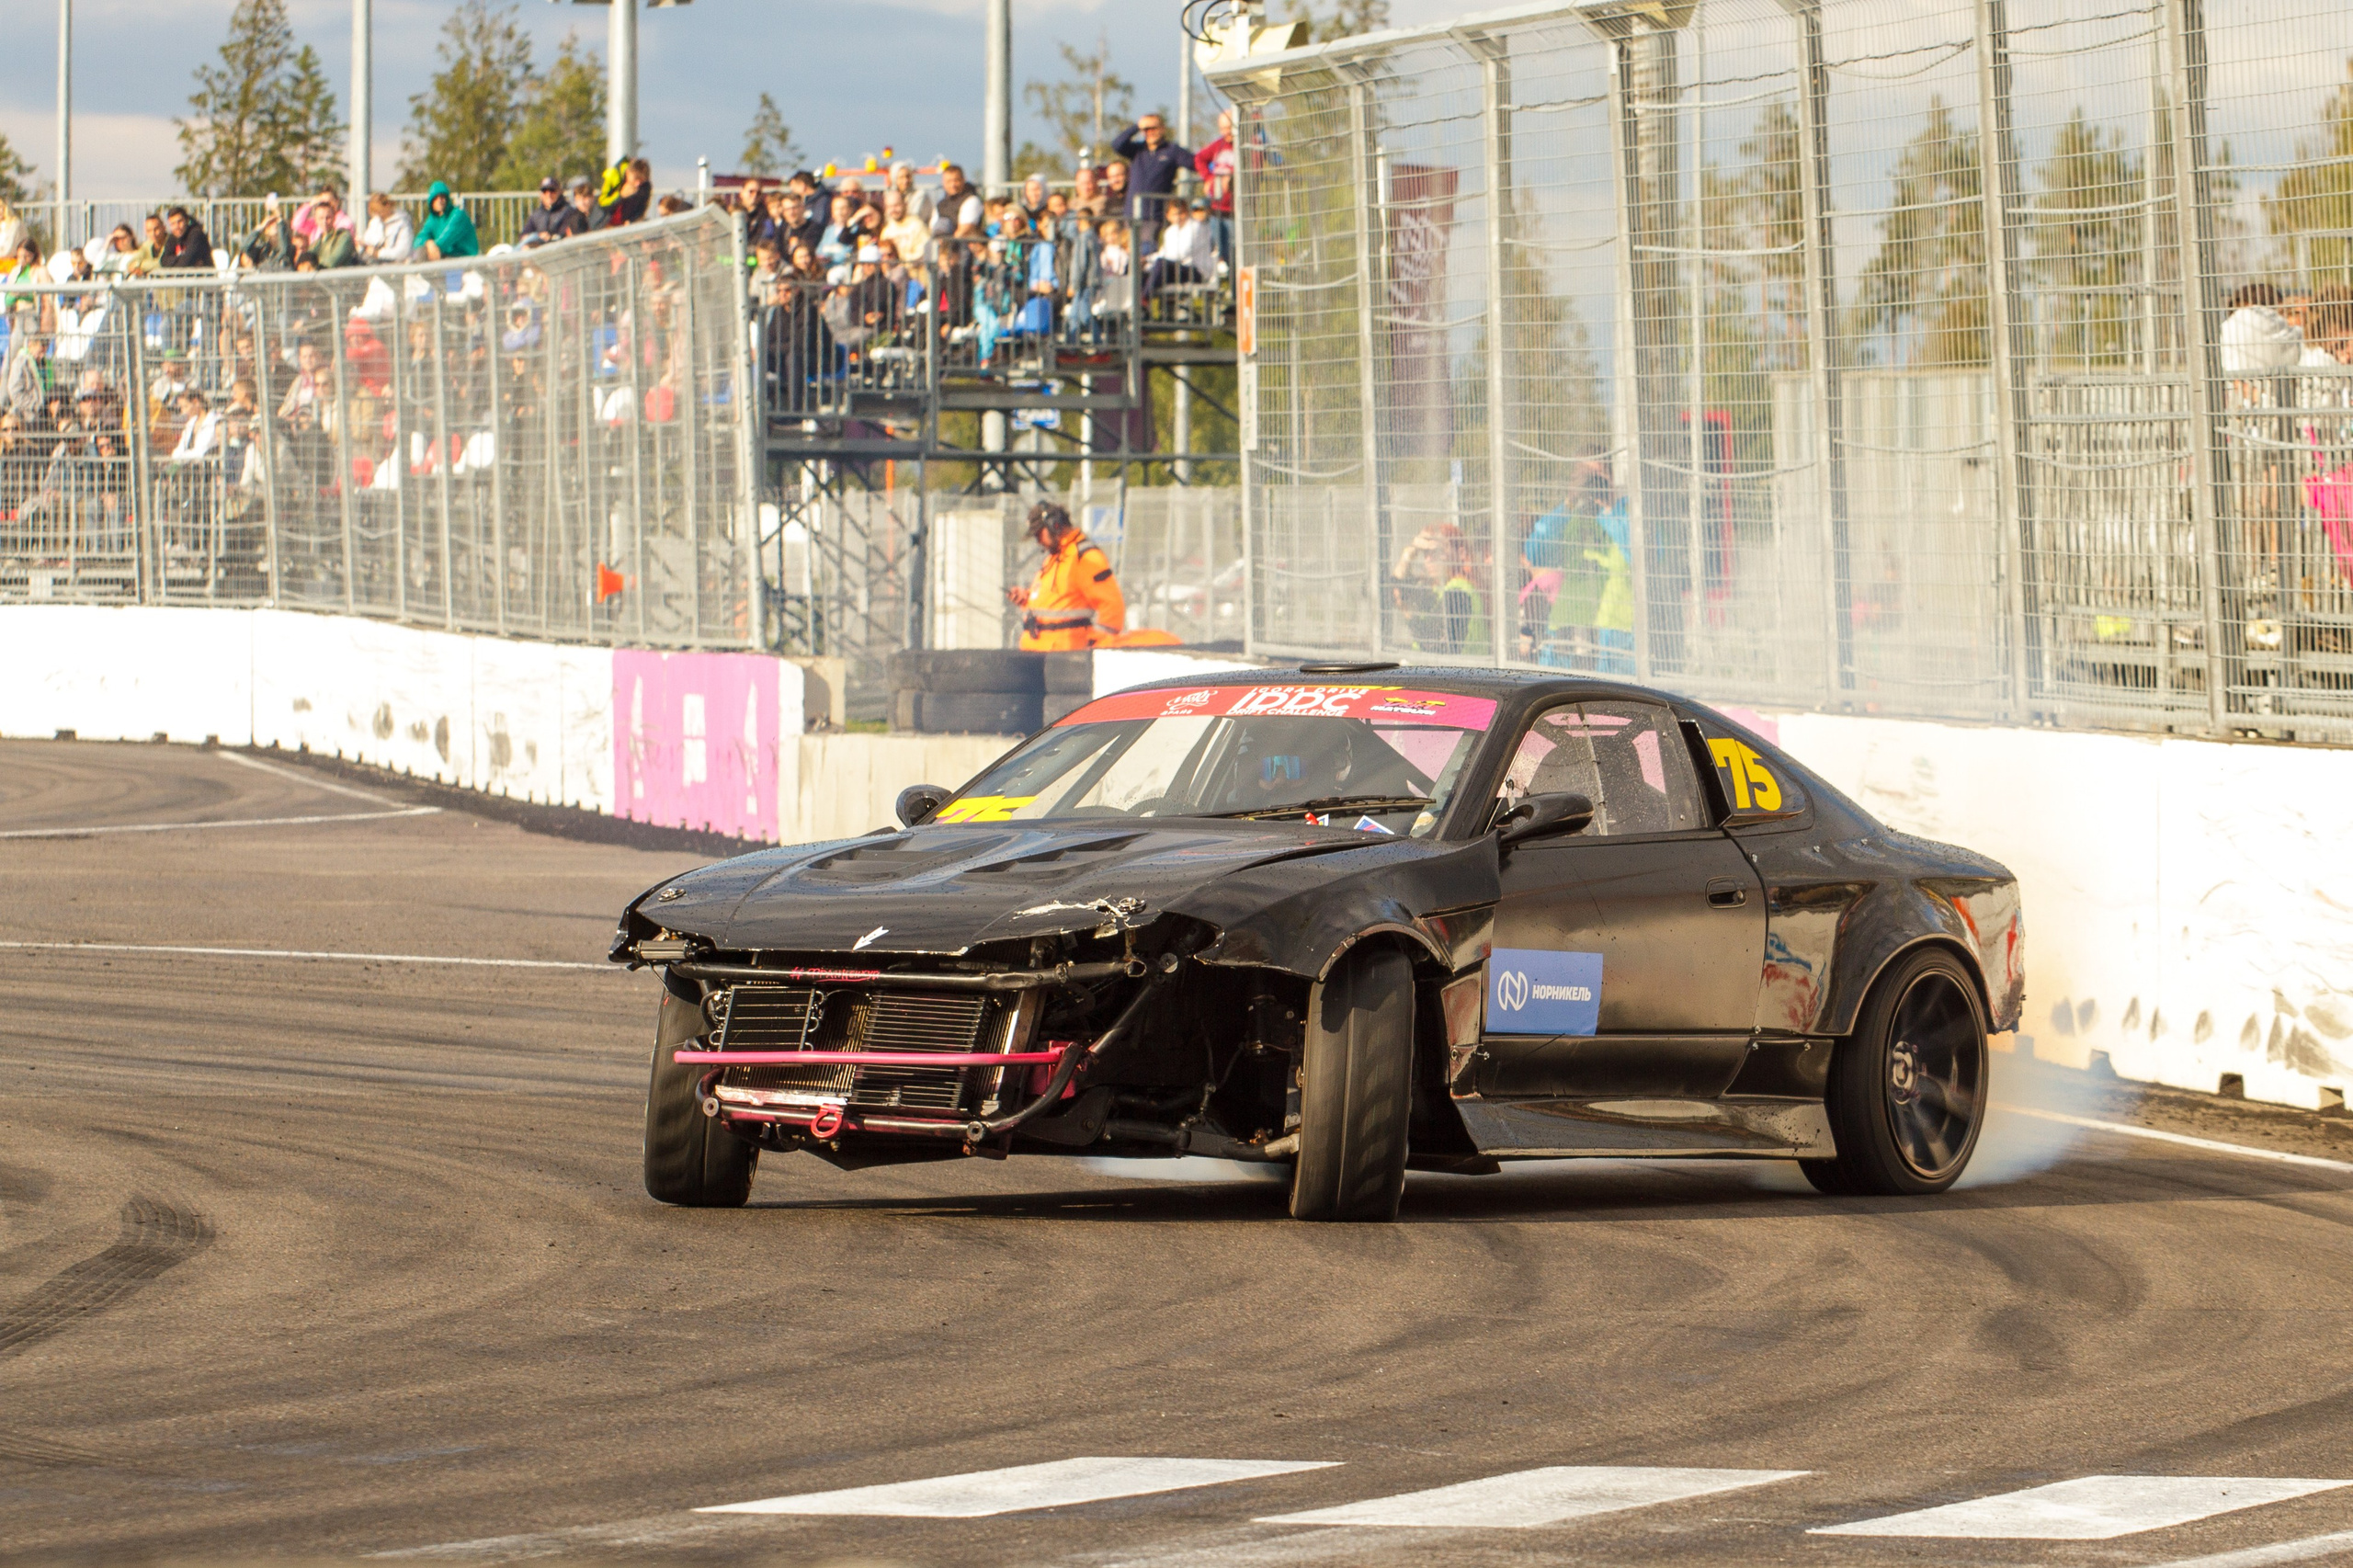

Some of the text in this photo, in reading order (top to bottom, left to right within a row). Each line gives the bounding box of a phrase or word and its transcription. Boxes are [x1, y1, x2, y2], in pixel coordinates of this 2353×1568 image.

[1231, 691, 1362, 710] IDDC
[1267, 708, 1347, 717] CHALLENGE
[1707, 738, 1782, 812] 75
[1531, 984, 1592, 1002] НОРНИКЕЛЬ
